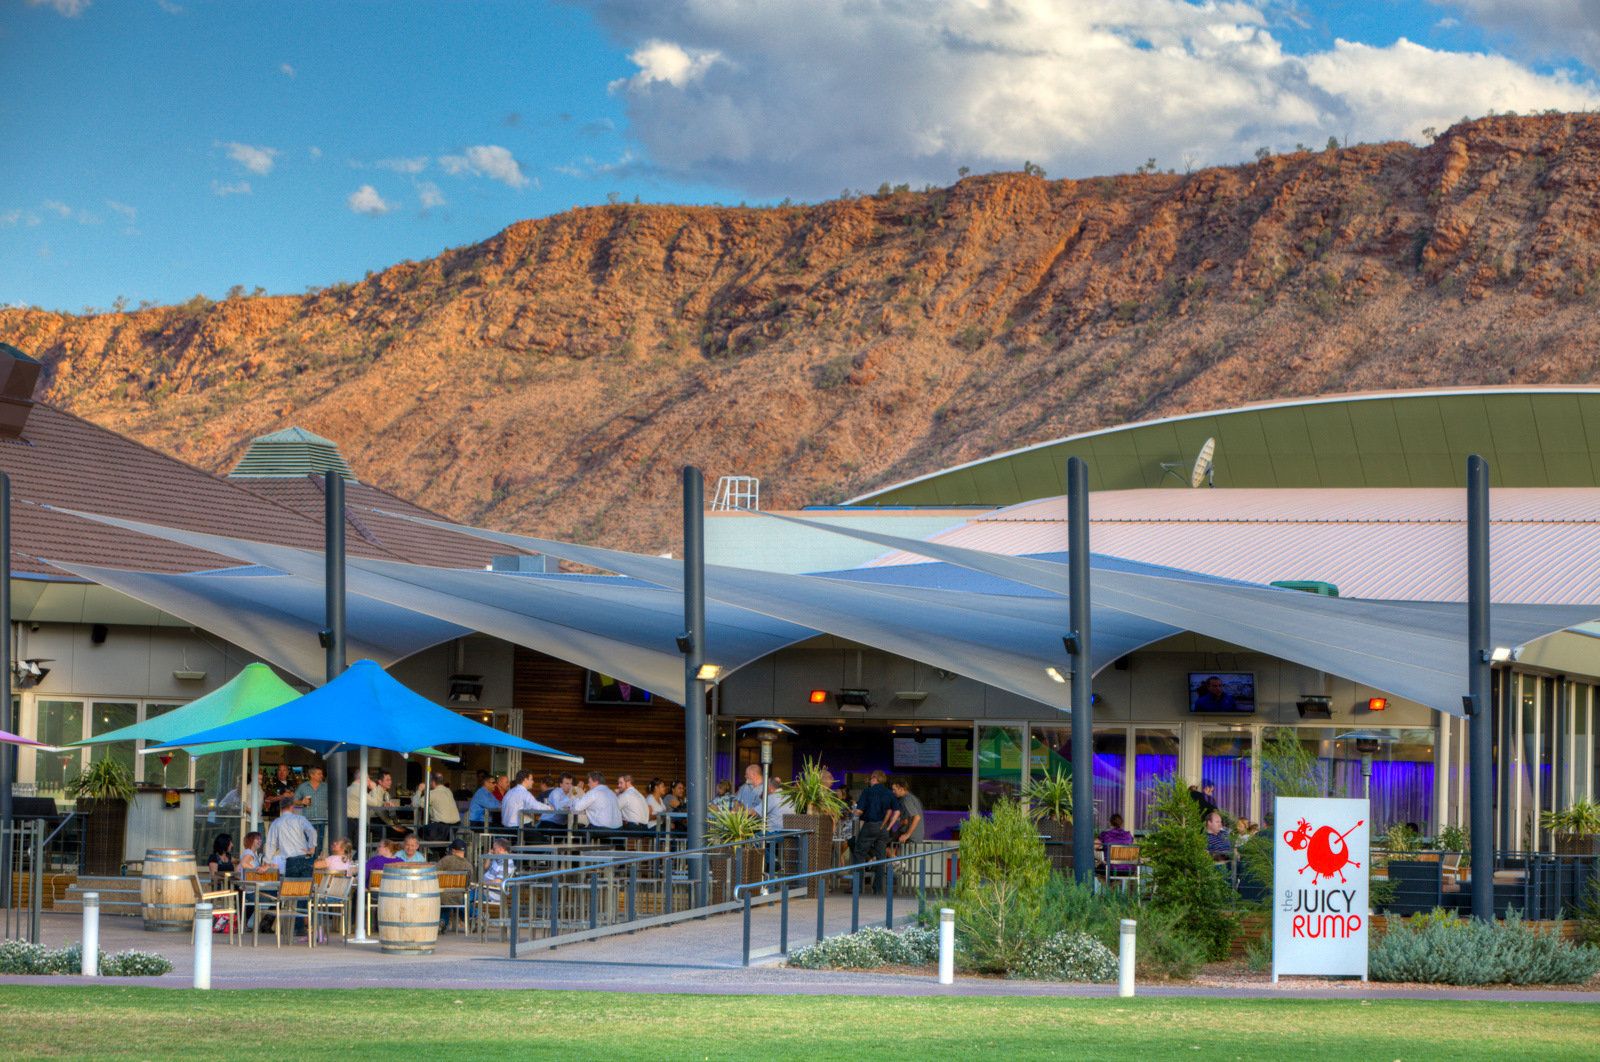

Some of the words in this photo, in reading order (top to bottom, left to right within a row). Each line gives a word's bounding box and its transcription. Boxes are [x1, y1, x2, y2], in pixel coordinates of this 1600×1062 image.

[1281, 890, 1293, 912] the
[1294, 889, 1356, 913] JUICY
[1293, 914, 1362, 938] RUMP
